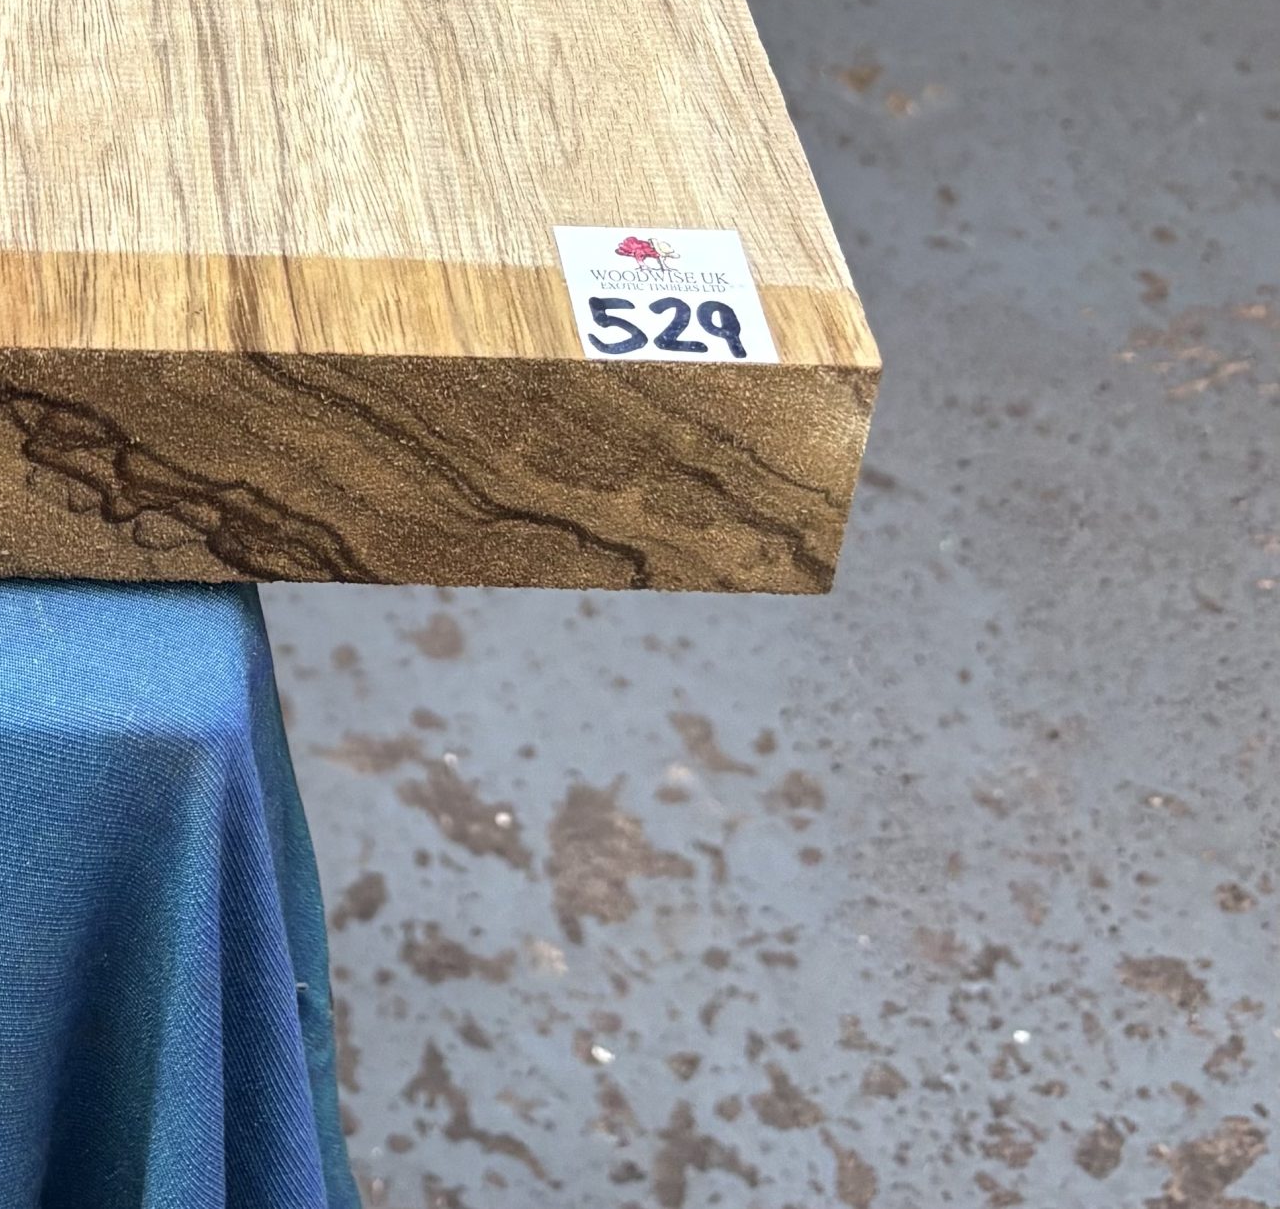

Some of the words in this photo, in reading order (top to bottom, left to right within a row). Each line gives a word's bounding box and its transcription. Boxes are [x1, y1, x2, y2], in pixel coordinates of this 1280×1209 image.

[590, 269, 695, 284] WOODWISE
[701, 272, 730, 285] UK
[601, 281, 645, 291] EXOTIC
[649, 283, 700, 293] TIMBERS
[703, 284, 726, 293] LTD
[588, 296, 747, 359] 529
